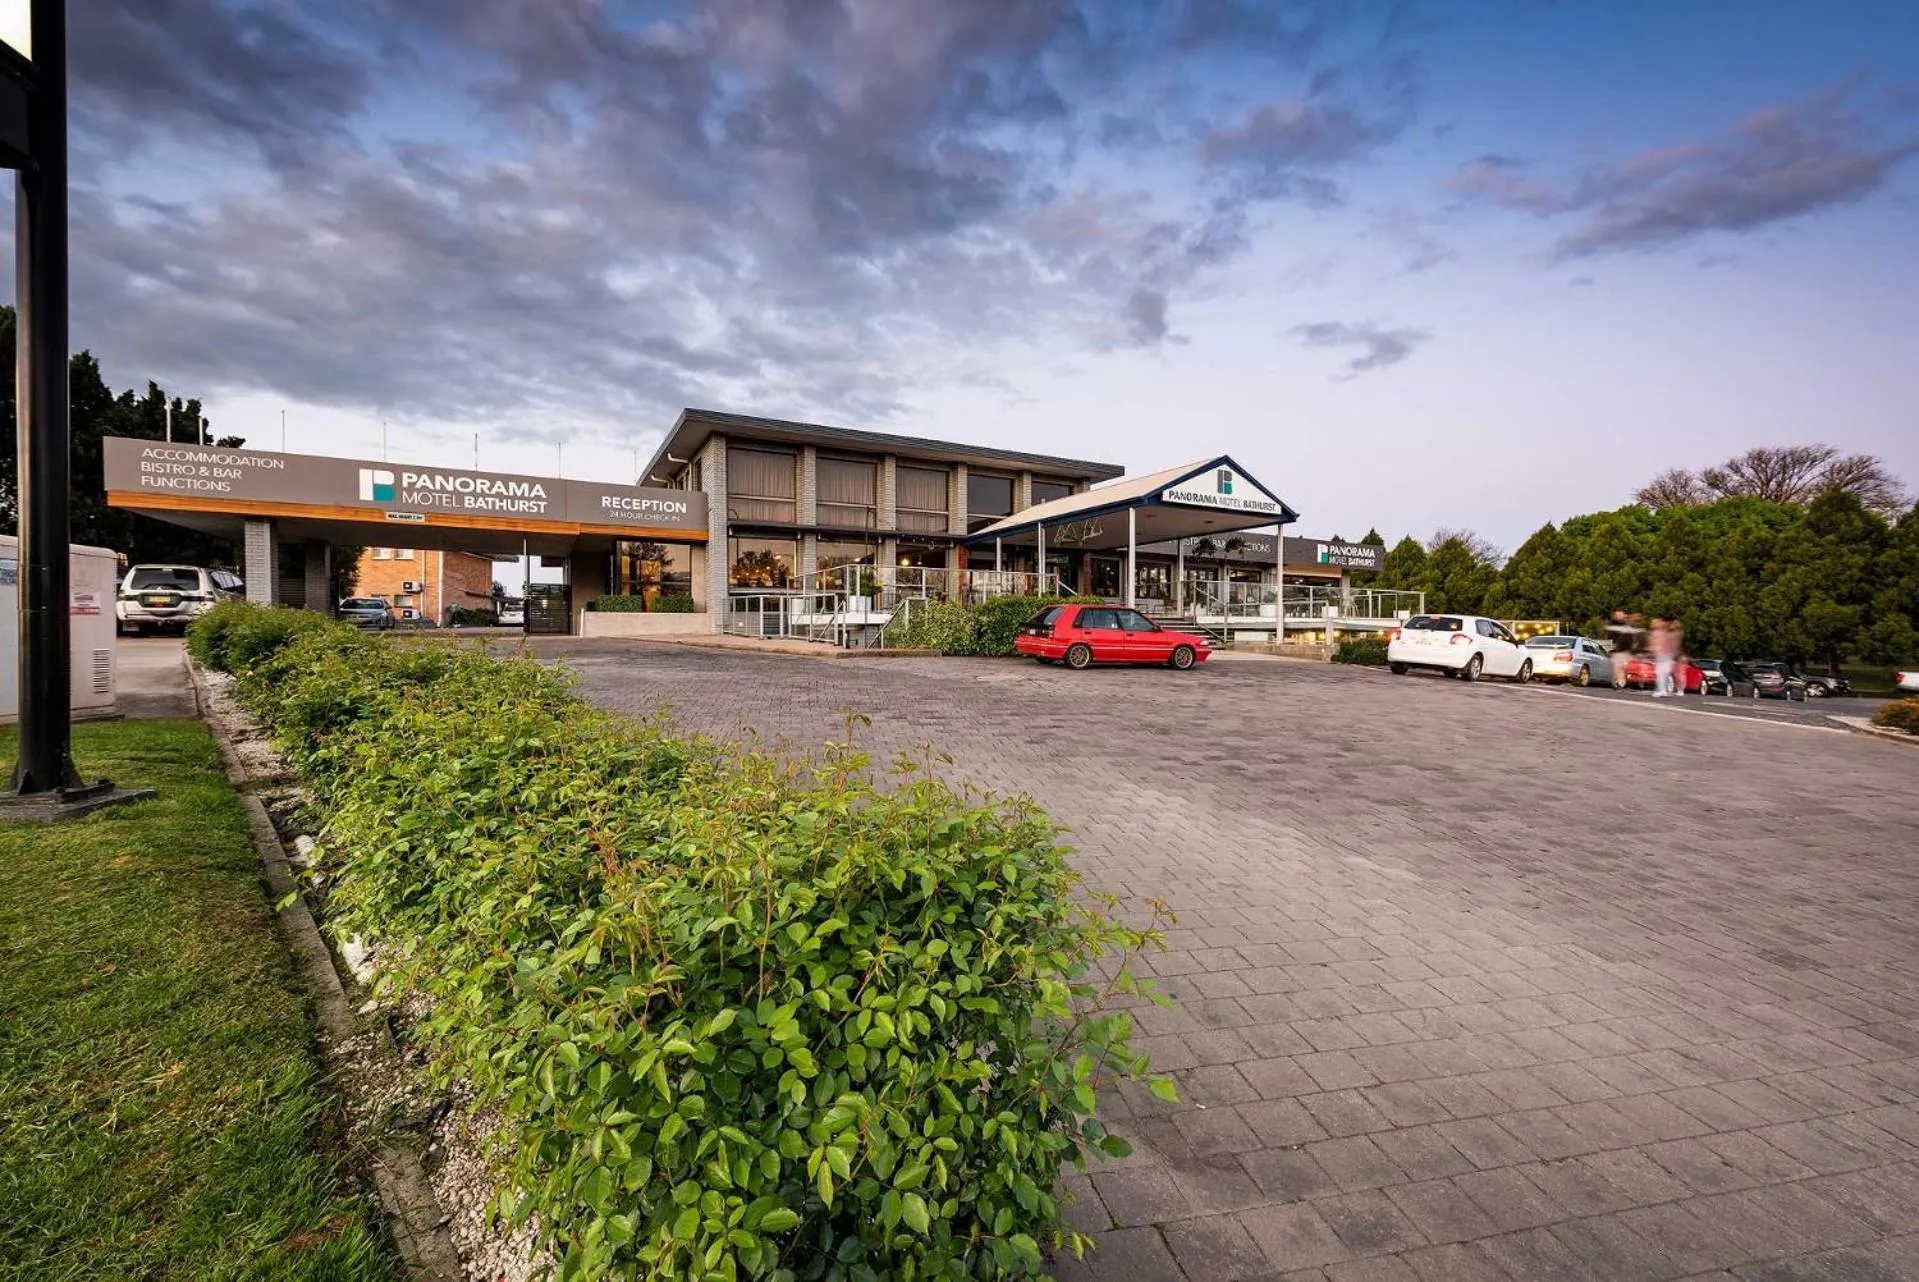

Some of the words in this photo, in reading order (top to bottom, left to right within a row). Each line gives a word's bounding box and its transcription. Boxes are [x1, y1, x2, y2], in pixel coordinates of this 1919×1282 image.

[141, 448, 284, 469] ACCOMMODATION
[141, 461, 195, 475] BISTRO
[199, 466, 210, 476] &
[213, 467, 242, 479] BAR
[141, 475, 231, 492] FUNCTIONS
[402, 472, 547, 498] PANORAMA
[402, 491, 460, 508] MOTEL
[464, 496, 547, 514] BATHURST
[602, 496, 687, 514] RECEPTION
[1168, 490, 1218, 505] PANORAMA
[1243, 499, 1276, 512] BATHURST
[1329, 545, 1376, 558] PANORAMA
[1348, 557, 1376, 567] BATHURST
